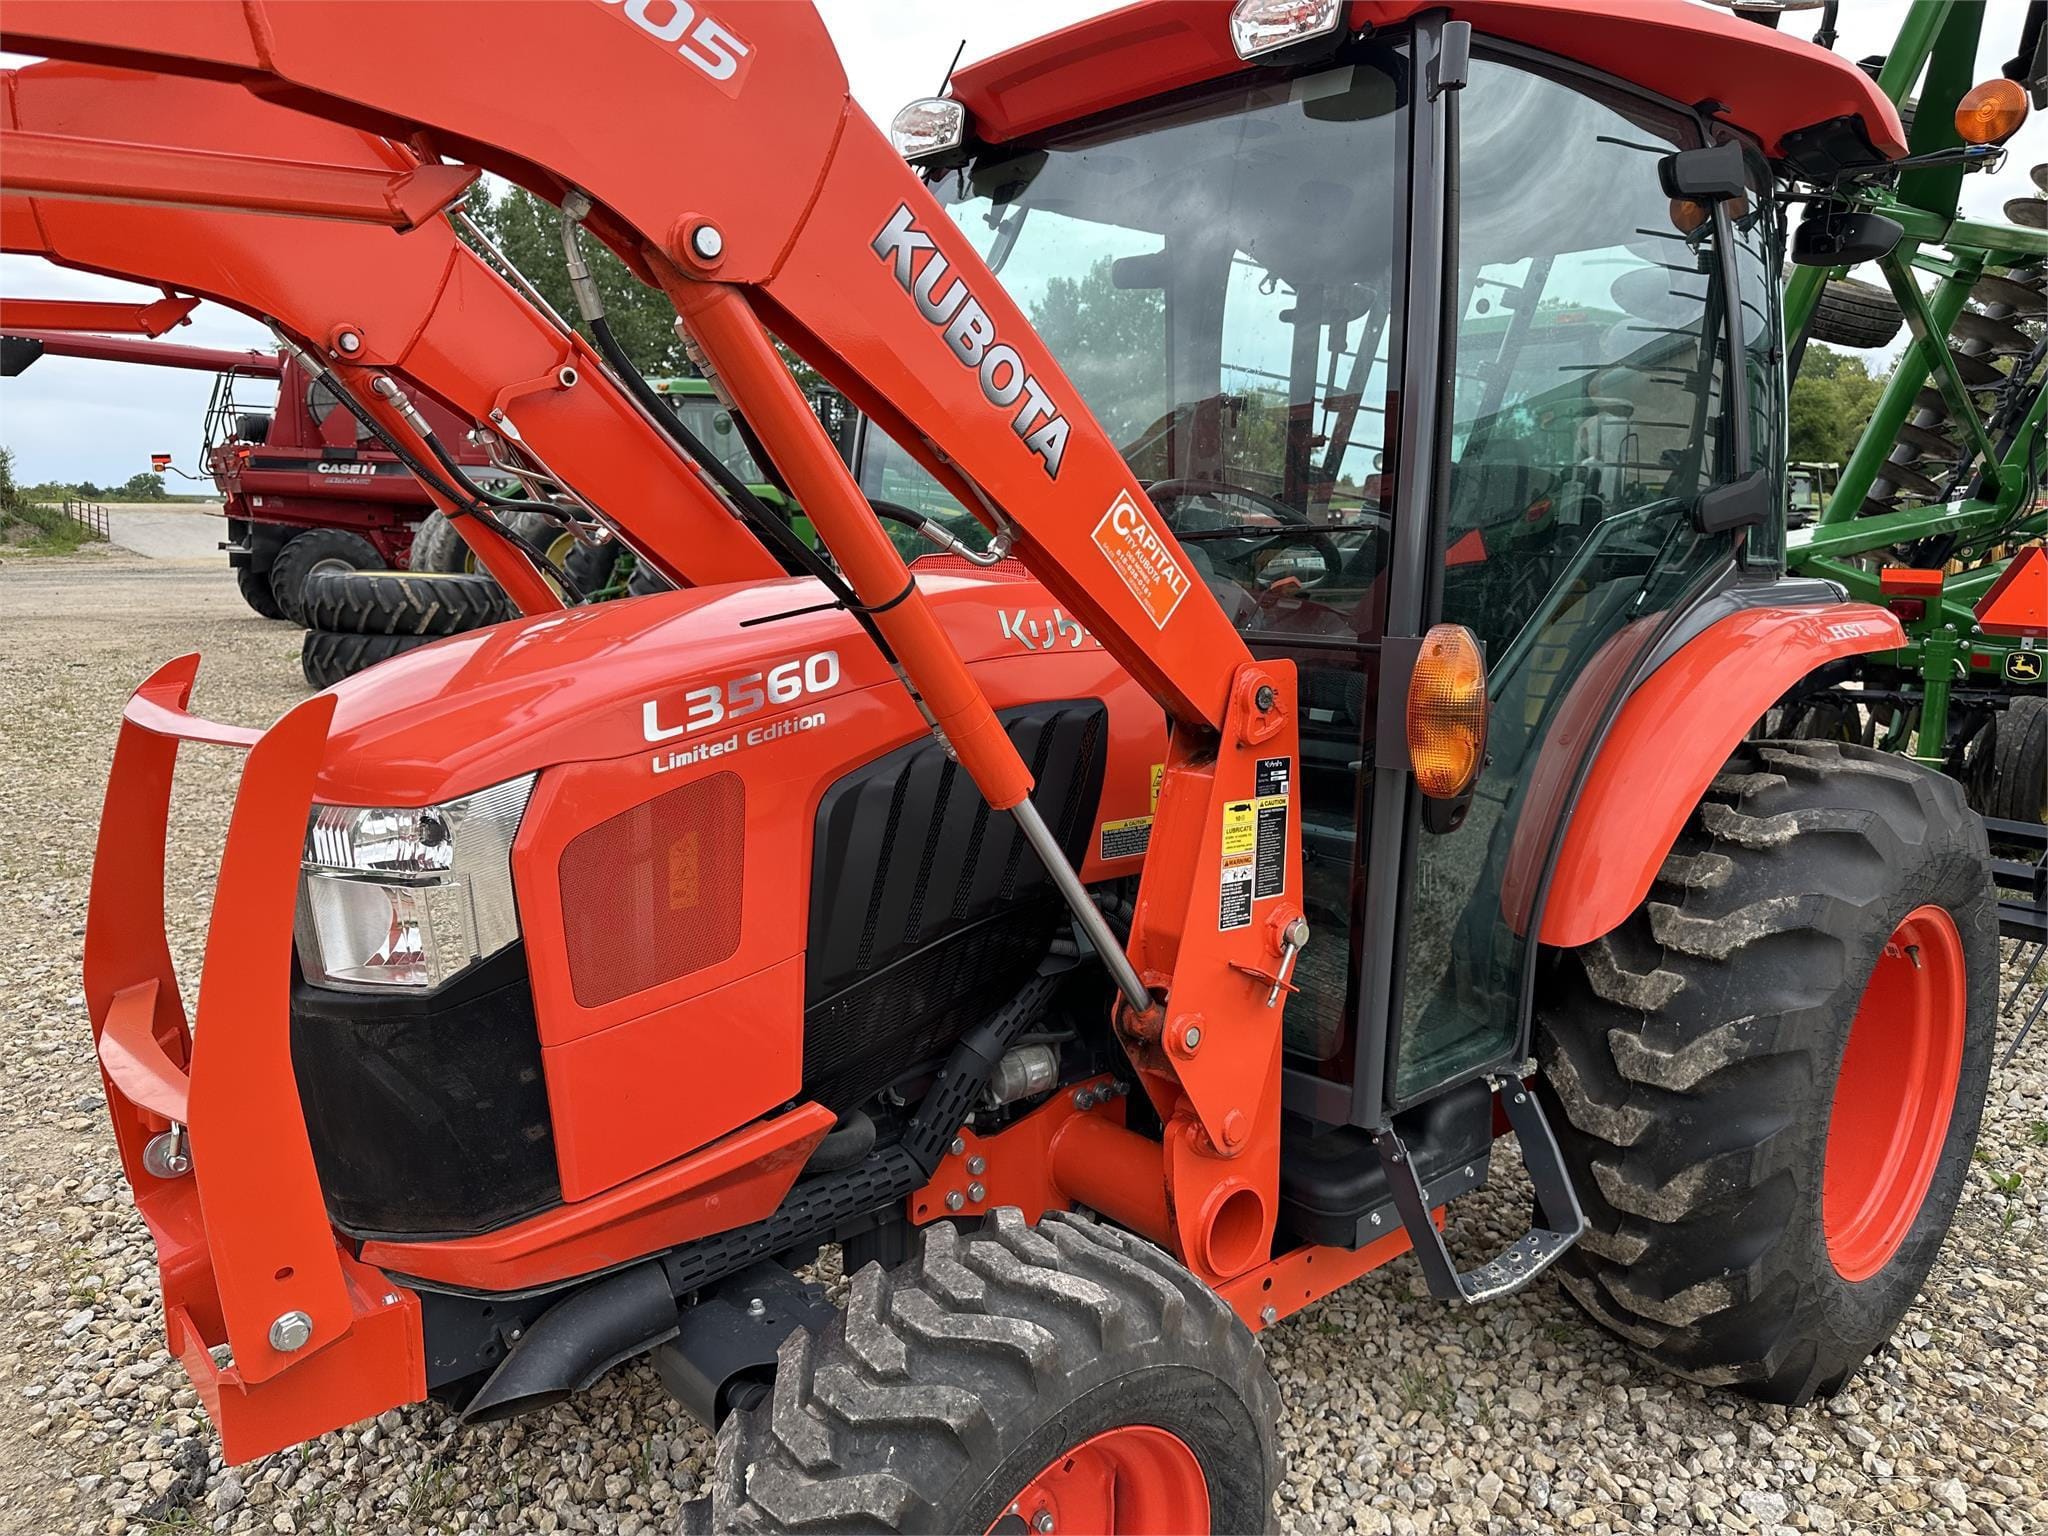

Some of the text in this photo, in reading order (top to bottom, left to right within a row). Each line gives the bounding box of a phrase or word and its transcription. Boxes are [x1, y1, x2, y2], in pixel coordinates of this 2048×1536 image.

[601, 0, 749, 80] 05
[871, 201, 1071, 480] KUBOTA
[317, 463, 361, 474] CASE
[1112, 503, 1182, 596] CAPITAL
[1135, 549, 1160, 585] KUBOTA
[998, 608, 1102, 650] Kub
[1826, 623, 1870, 640] HST
[643, 650, 840, 742] L3560
[652, 712, 826, 774] Limited Edition
[1264, 799, 1287, 807] CAUTION
[1225, 825, 1253, 834] LUBRICATE
[1228, 856, 1252, 866] WARNING
